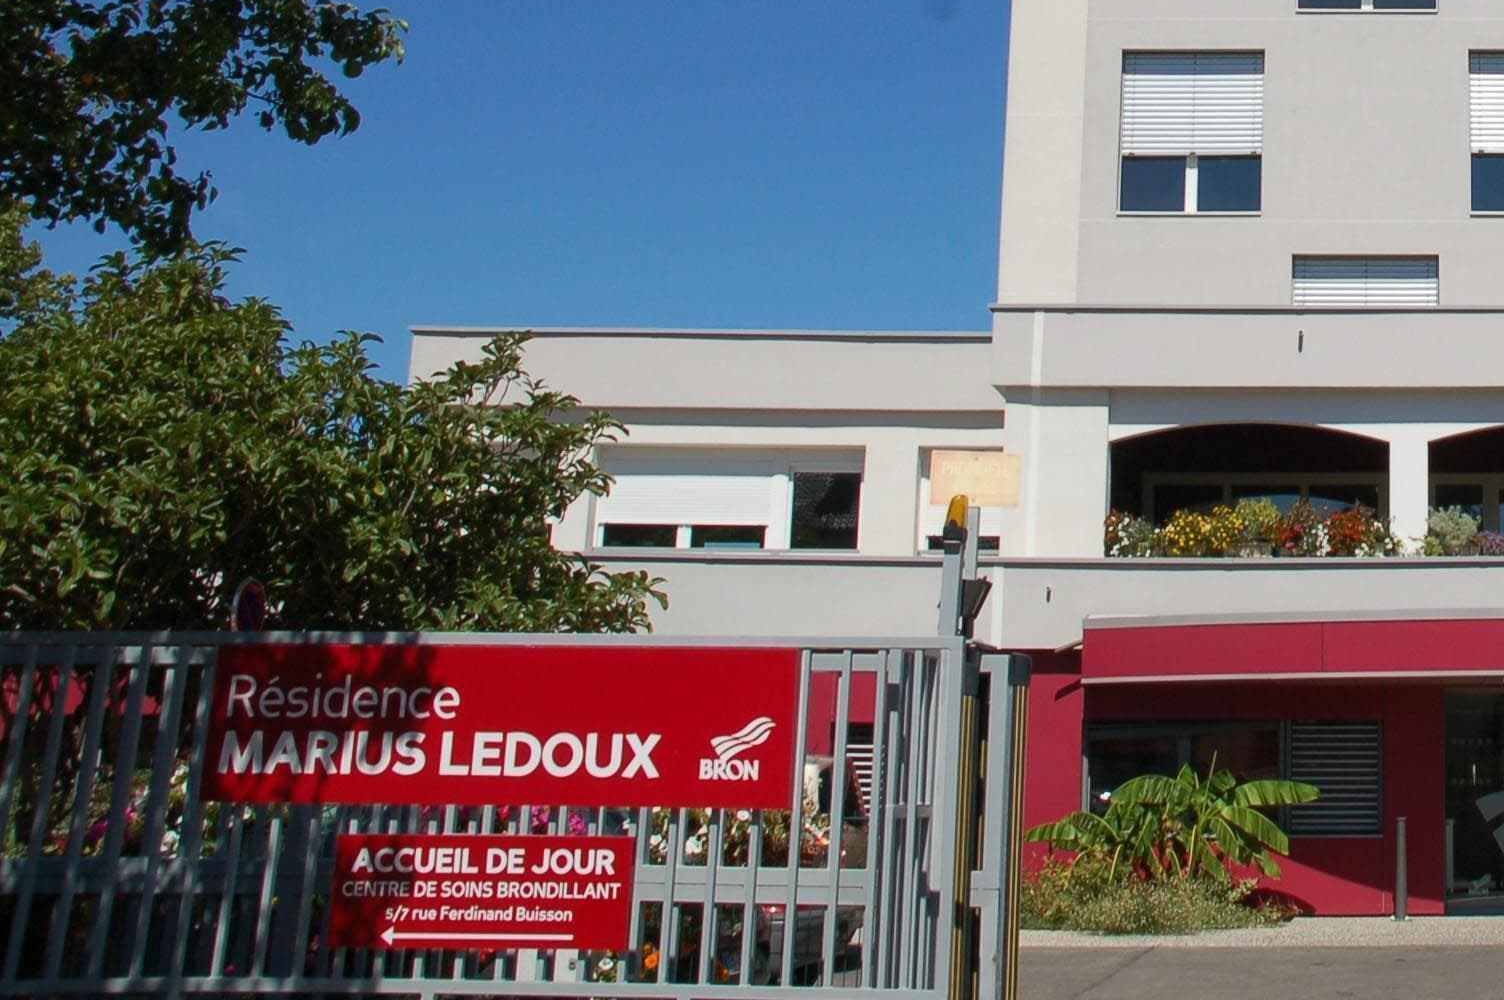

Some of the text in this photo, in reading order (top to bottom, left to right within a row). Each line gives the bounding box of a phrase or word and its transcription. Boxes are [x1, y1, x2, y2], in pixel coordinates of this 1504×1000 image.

[227, 673, 461, 720] Résidence
[217, 730, 662, 780] MARIUS LEDOUX
[699, 757, 760, 781] BRON
[351, 847, 616, 876] ACCUEIL DE JOUR
[341, 880, 622, 901] CENTRE DE SOINS BRONDILLANT
[384, 905, 573, 923] 5/7 rue Ferdinand Buisson
